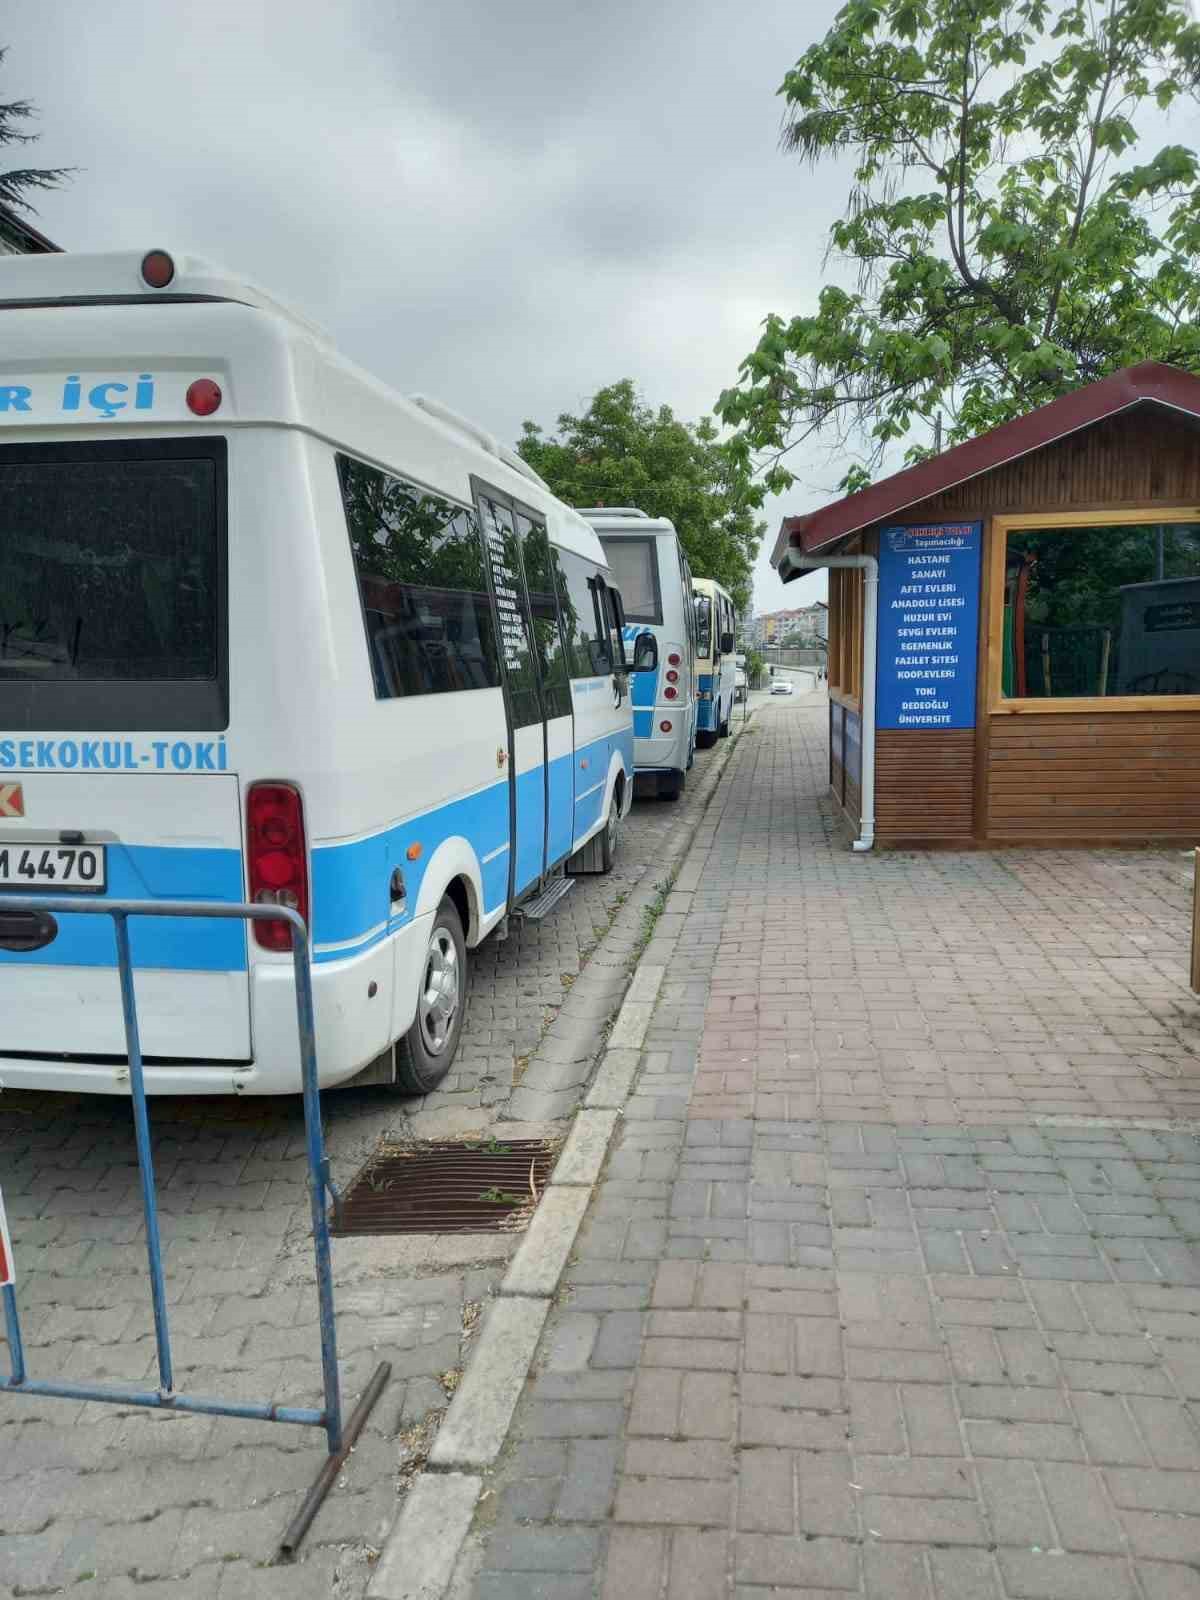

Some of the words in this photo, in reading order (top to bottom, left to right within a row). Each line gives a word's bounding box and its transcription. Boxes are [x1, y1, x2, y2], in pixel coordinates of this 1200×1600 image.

[907, 554, 951, 564] HASTANE
[901, 585, 923, 594] AFET
[891, 599, 937, 608] ANADOLU
[903, 613, 935, 622] HUZUR
[902, 699, 949, 710] DEDEOĞLU
[18, 849, 98, 881] 4470
